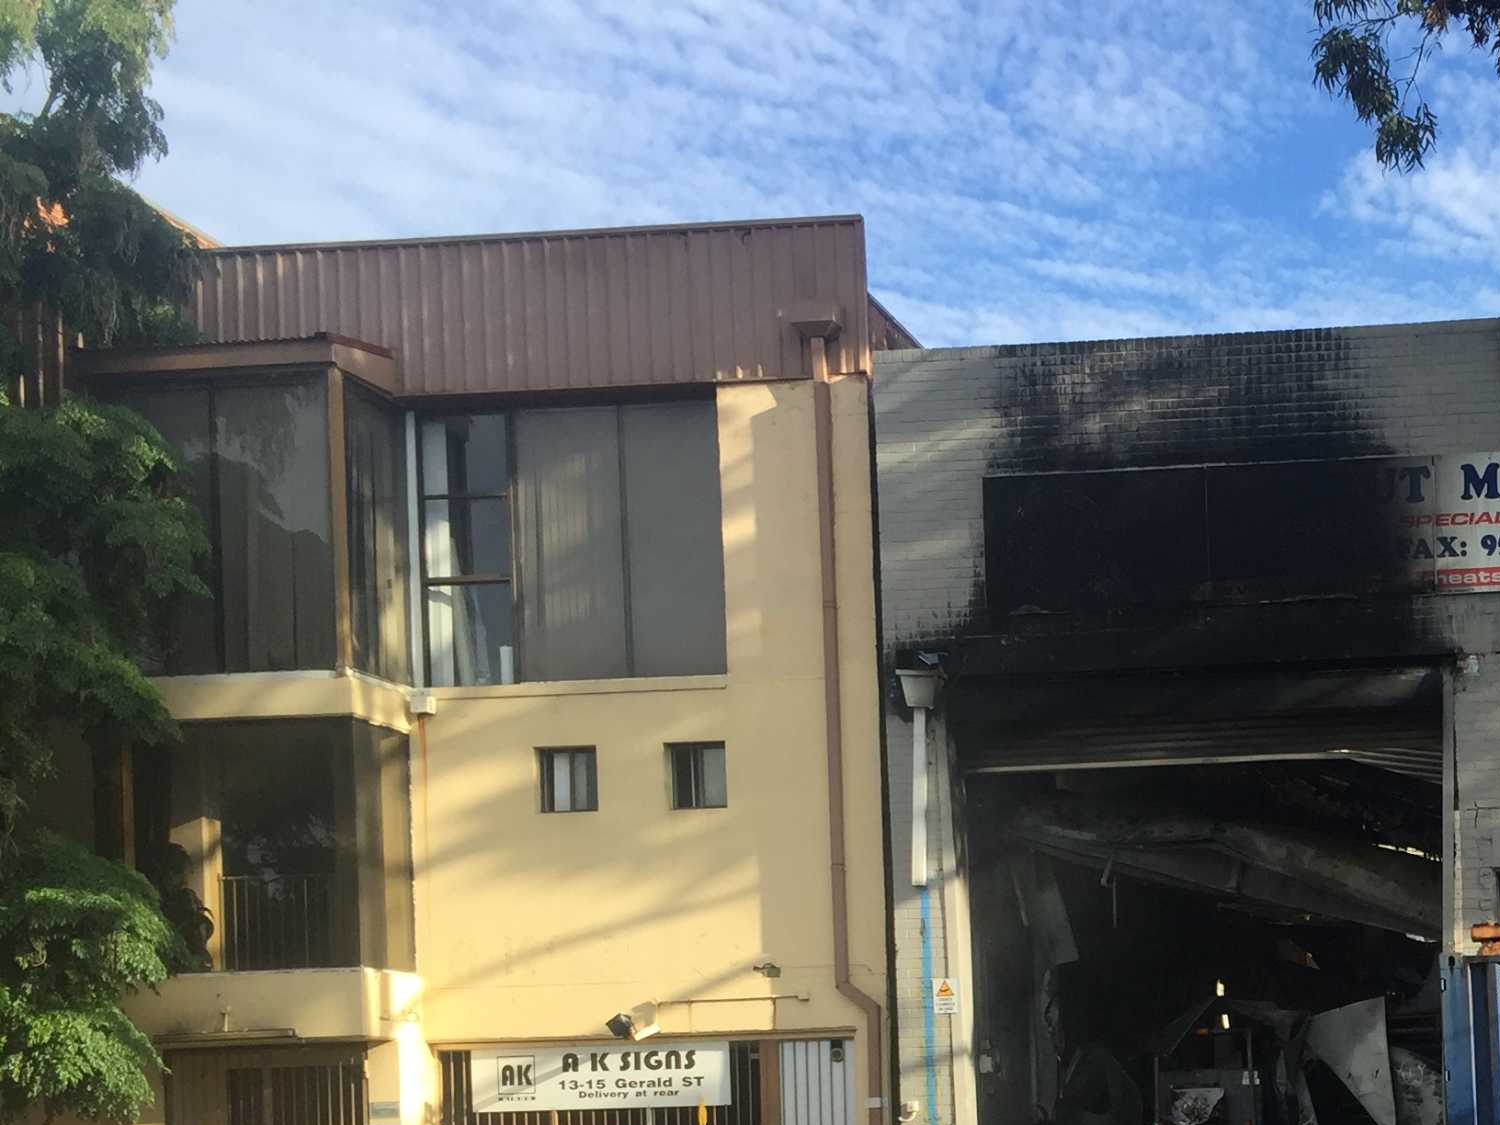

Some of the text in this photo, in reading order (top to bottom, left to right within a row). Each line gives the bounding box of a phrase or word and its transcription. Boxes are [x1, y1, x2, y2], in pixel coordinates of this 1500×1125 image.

[1401, 534, 1468, 560] FAX:
[562, 1050, 697, 1073] A K SIGNS
[501, 1063, 533, 1087] AK
[559, 1075, 705, 1091] 13-15 Gerald ST
[578, 1088, 680, 1101] Delivery at rear
